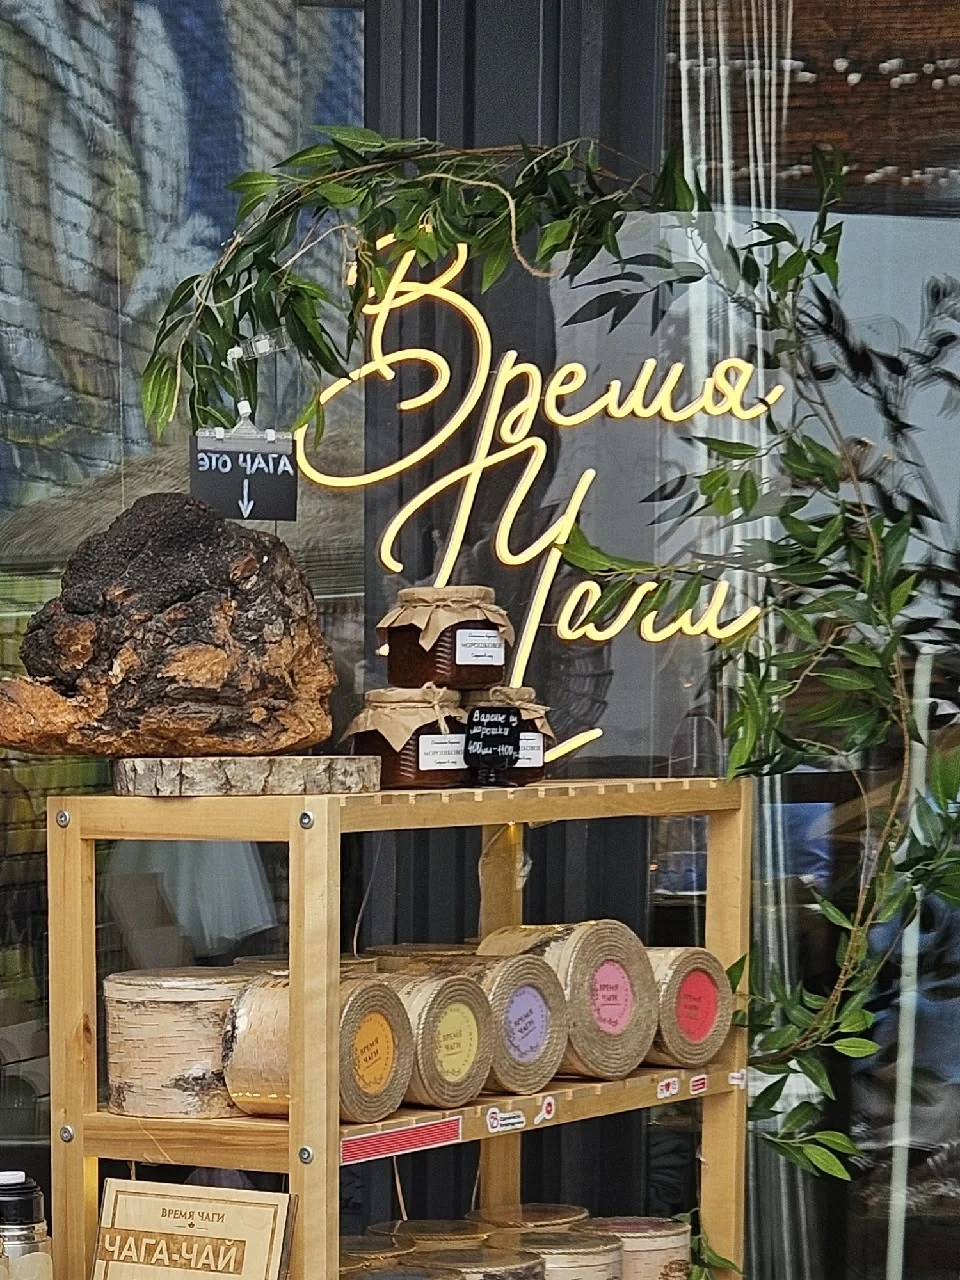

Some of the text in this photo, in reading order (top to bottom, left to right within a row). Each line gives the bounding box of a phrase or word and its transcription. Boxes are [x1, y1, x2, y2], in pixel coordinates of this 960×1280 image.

[296, 222, 785, 590] Время
[197, 451, 294, 477] ЭТО ЧАГА
[160, 1207, 226, 1223] ВРЕМЯ ЧАГИ
[104, 1234, 237, 1272] ЧАГА-ЧАЙ
